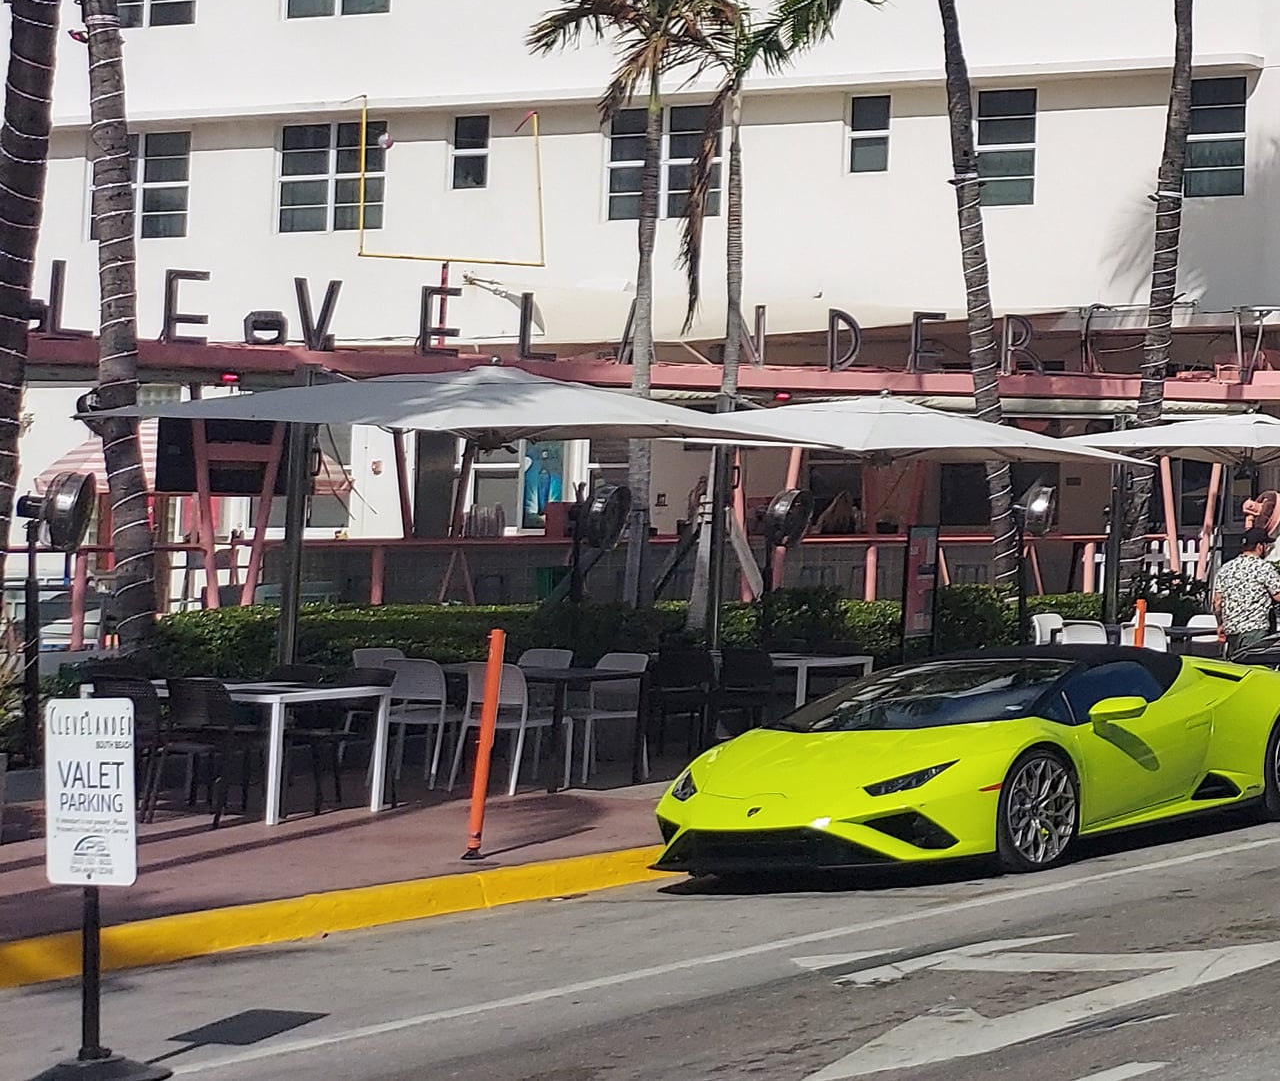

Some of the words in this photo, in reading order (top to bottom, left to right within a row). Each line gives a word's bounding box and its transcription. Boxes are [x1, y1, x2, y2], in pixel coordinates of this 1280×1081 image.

[50, 706, 133, 736] CLEVELANDER
[58, 761, 125, 789] VALET
[60, 793, 123, 814] PARKING
